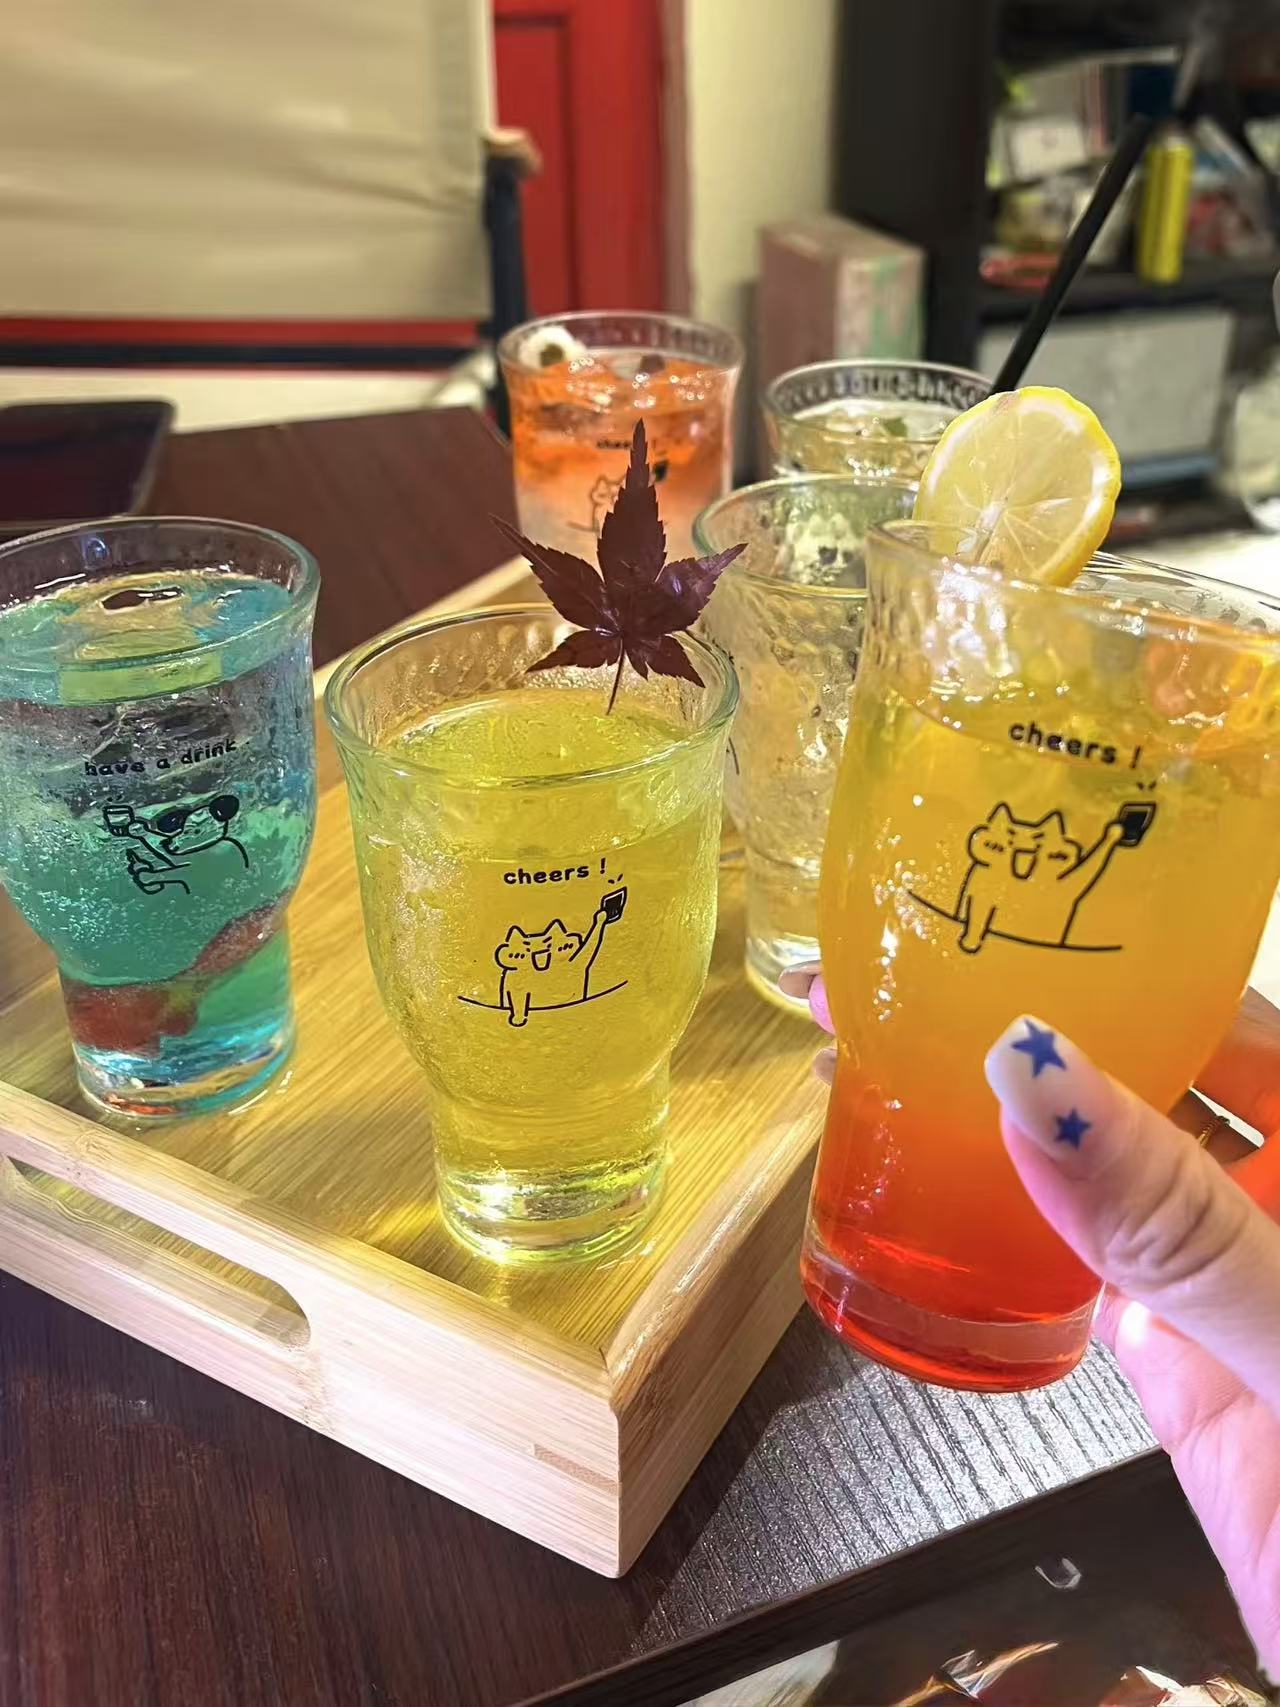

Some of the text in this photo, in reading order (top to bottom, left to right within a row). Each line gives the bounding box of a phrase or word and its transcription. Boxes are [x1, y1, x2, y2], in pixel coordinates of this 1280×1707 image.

[85, 739, 237, 776] have a drink
[503, 867, 590, 885] cheers
